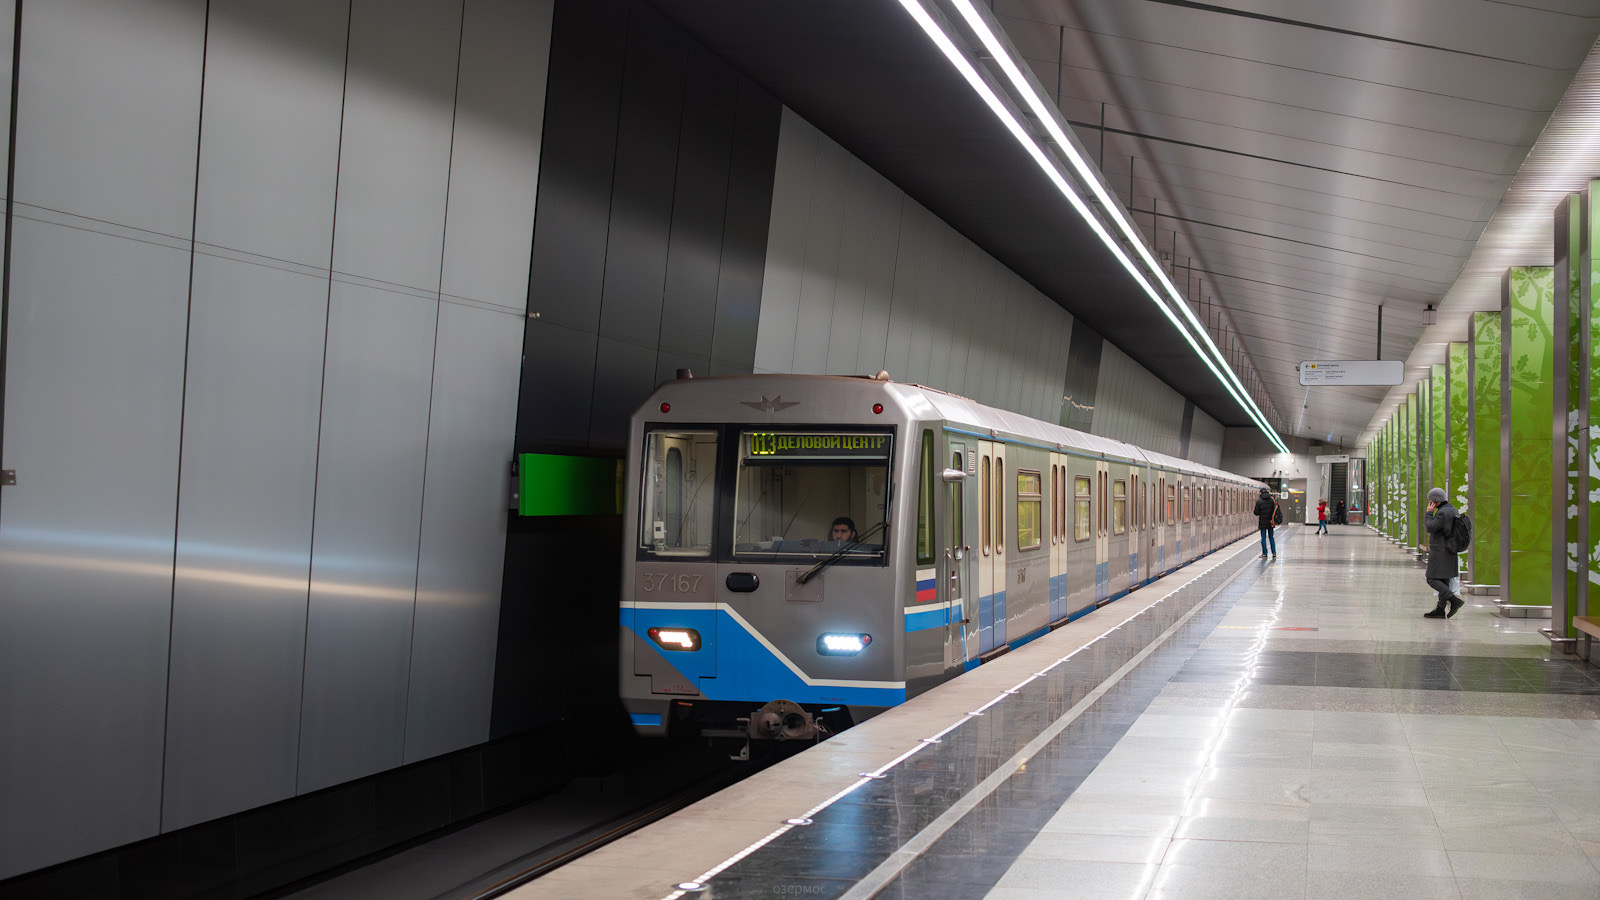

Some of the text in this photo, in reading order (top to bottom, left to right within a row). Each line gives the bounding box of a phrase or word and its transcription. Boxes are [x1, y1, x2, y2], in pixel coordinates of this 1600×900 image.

[777, 435, 840, 450] ДЕЛОВОЙ
[842, 436, 886, 450] ЦЕНТР
[643, 573, 704, 593] 37167
